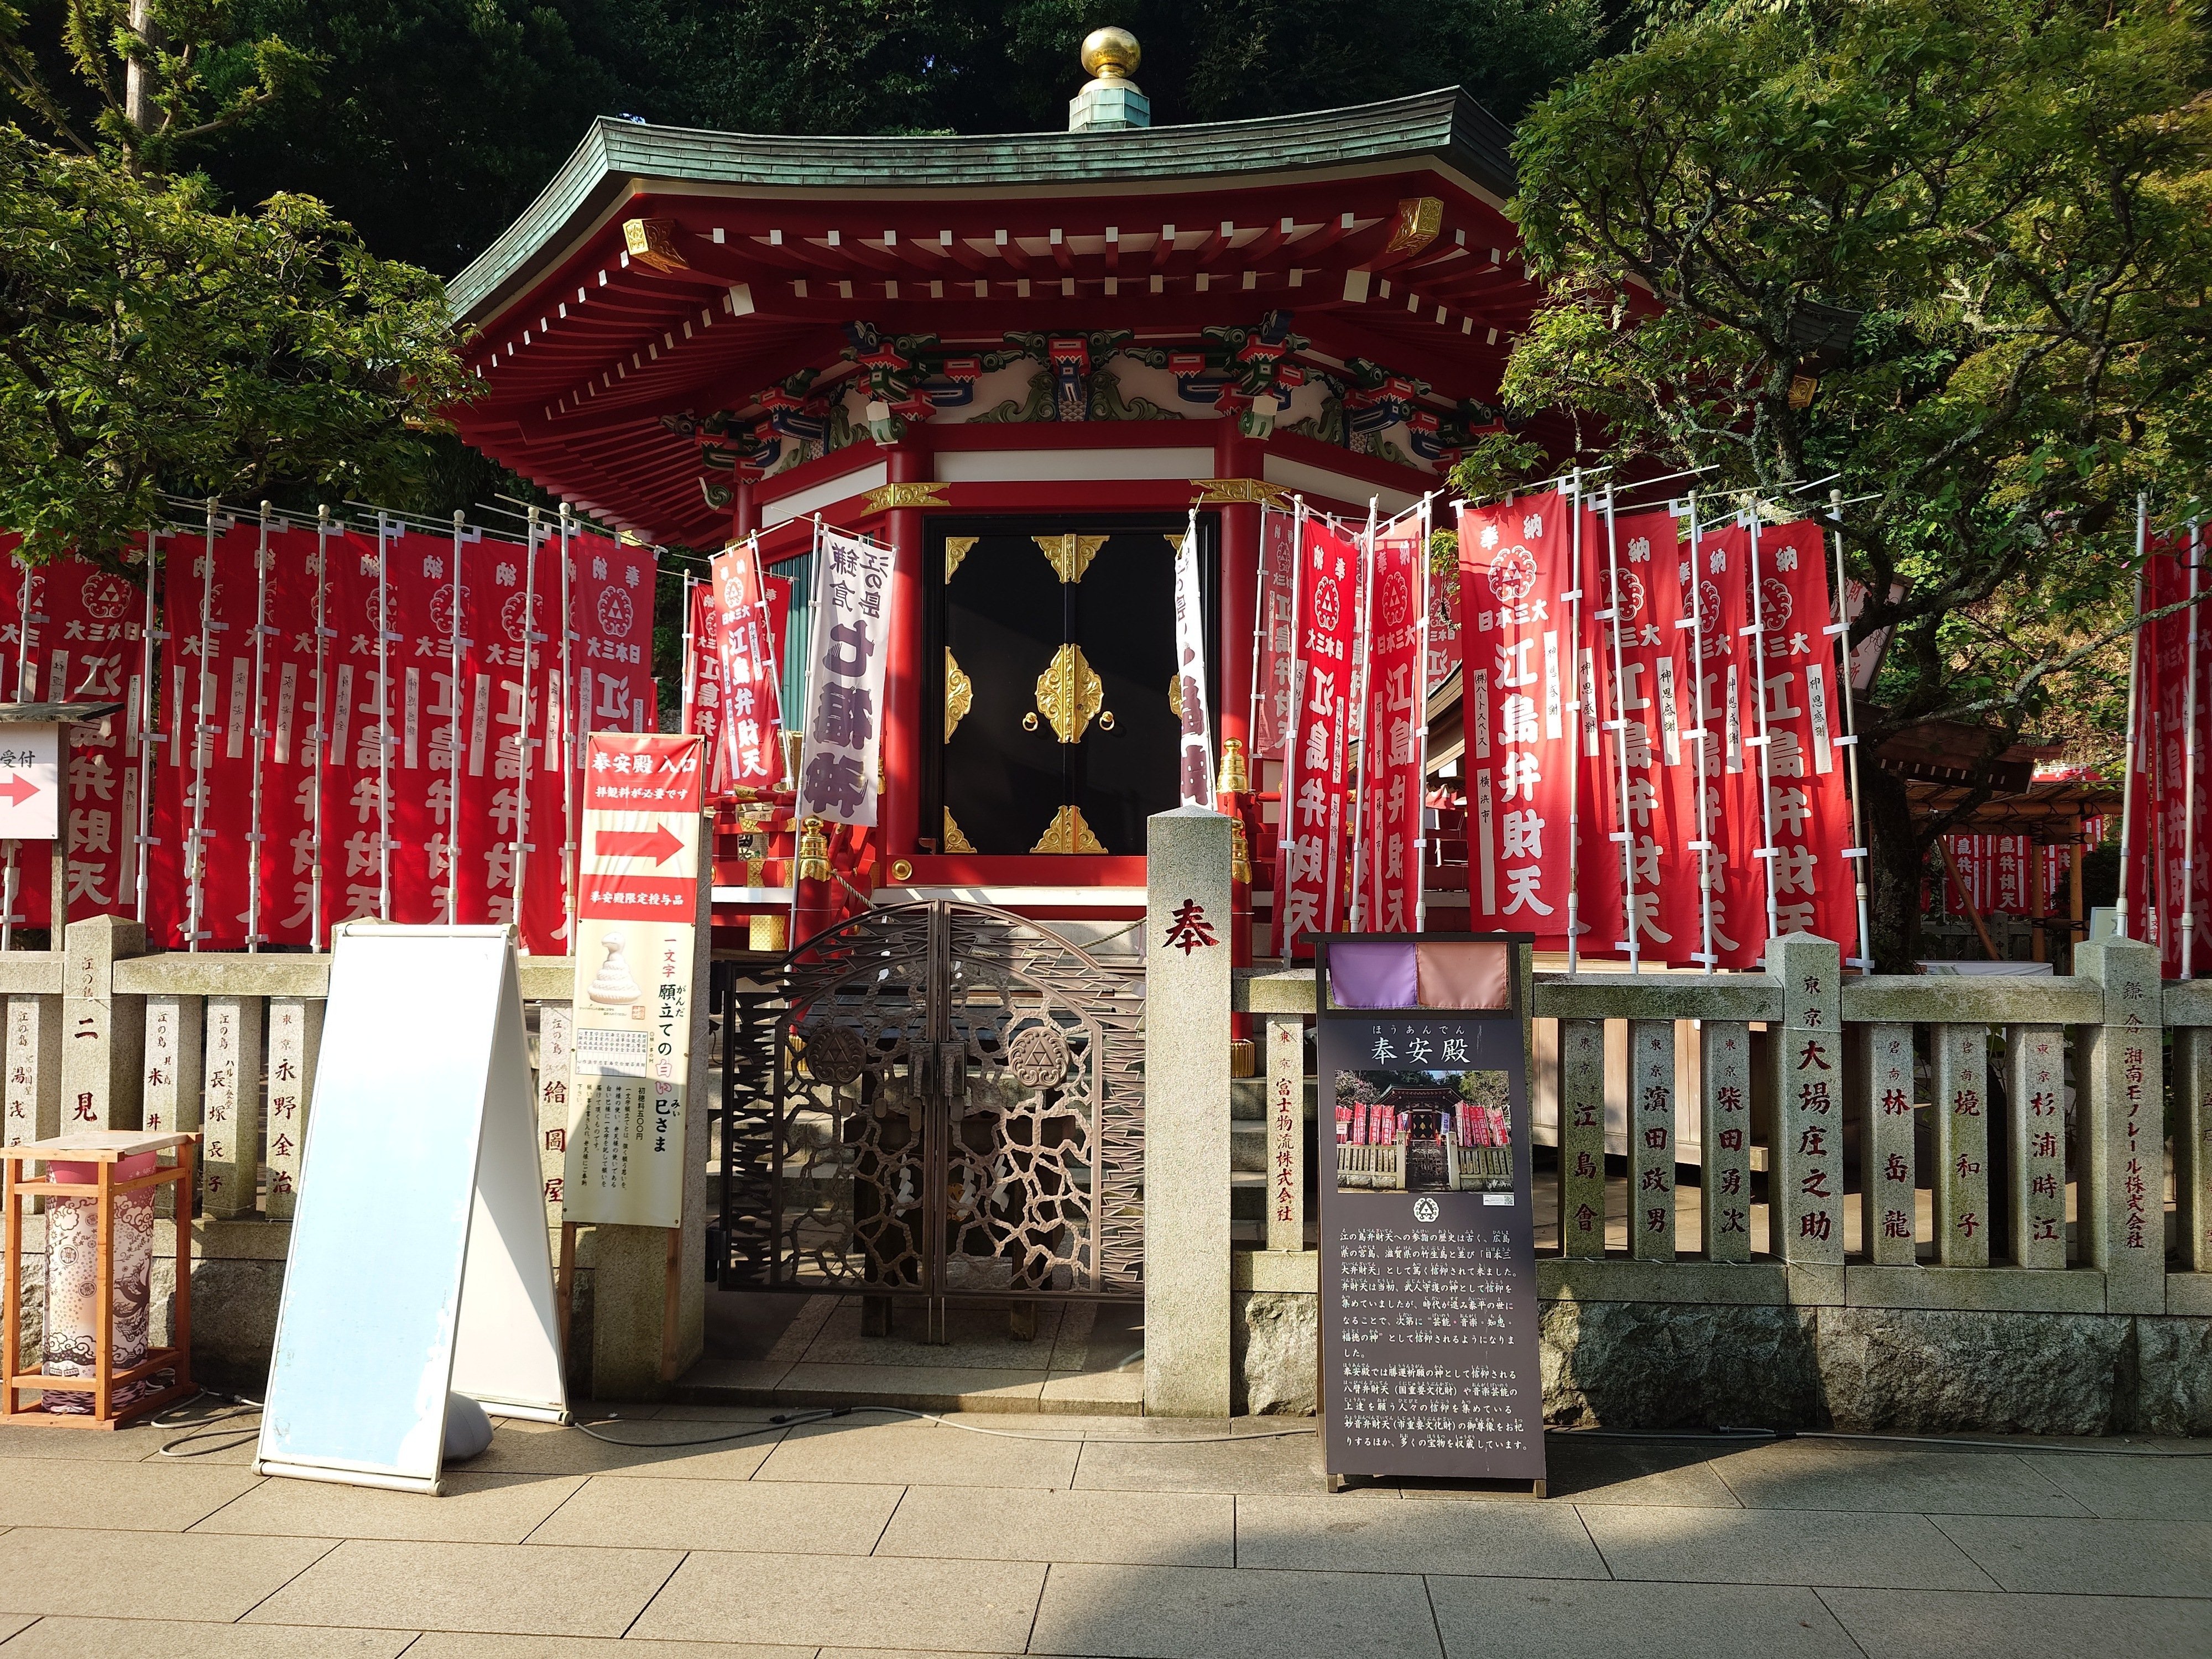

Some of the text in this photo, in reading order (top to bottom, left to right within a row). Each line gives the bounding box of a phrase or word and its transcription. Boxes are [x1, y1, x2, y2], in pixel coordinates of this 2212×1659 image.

[1479, 513, 1543, 551] 奉納
[1628, 536, 1651, 563] 納
[1775, 545, 1798, 573] 納
[1377, 624, 1417, 655] 日本三大
[1478, 598, 1550, 633] 日本三大
[728, 625, 768, 779] 江島弁財天
[1580, 662, 1595, 733] 神恩感謝
[1659, 669, 1676, 733] 神恩感謝
[1726, 676, 1739, 747] 神恩感謝
[1808, 676, 1825, 738] 神恩感謝
[1, 749, 36, 768] 受付
[591, 751, 697, 774] 奉安殿 入口
[1494, 637, 1555, 918] 江島弁財天
[1480, 775, 1490, 824] 横浜市
[589, 890, 685, 906] 奉安殿限定授与品
[1162, 898, 1220, 957] 奉
[662, 937, 677, 978] 一文字
[157, 1011, 168, 1048] 江の島
[1370, 1036, 1472, 1066] 奉安殿
[1373, 1024, 1465, 1036] ほうあんでん
[1578, 1036, 1591, 1076] 東京
[72, 1018, 98, 1123] 二見
[208, 1070, 227, 1193] 長塚長子
[271, 1058, 297, 1196] 永野金治
[1796, 975, 1832, 1242] 東京 大場庄之助
[2122, 980, 2147, 1250] 鎌倉 湘南モノレール株式会社
[1275, 1077, 1295, 1223] 富士物流株式会社
[1642, 1039, 1671, 1233] 東京 濱田政男
[1717, 1039, 1746, 1234] 東京 柴田勇次
[2031, 1044, 2059, 1241] 東京 杉浦時江
[1574, 1101, 1598, 1233] 江島會
[1953, 1089, 1981, 1239] 境和子
[1343, 1368, 1516, 1379] 奉安殿では勝運祈願の神として信仰される
[1344, 1348, 1365, 1358] した。
[1344, 1402, 1512, 1414] 上達を願う人々の信仰を集めている
[1347, 1437, 1527, 1450] りするほか、多くの宝物を収蔵しています。
